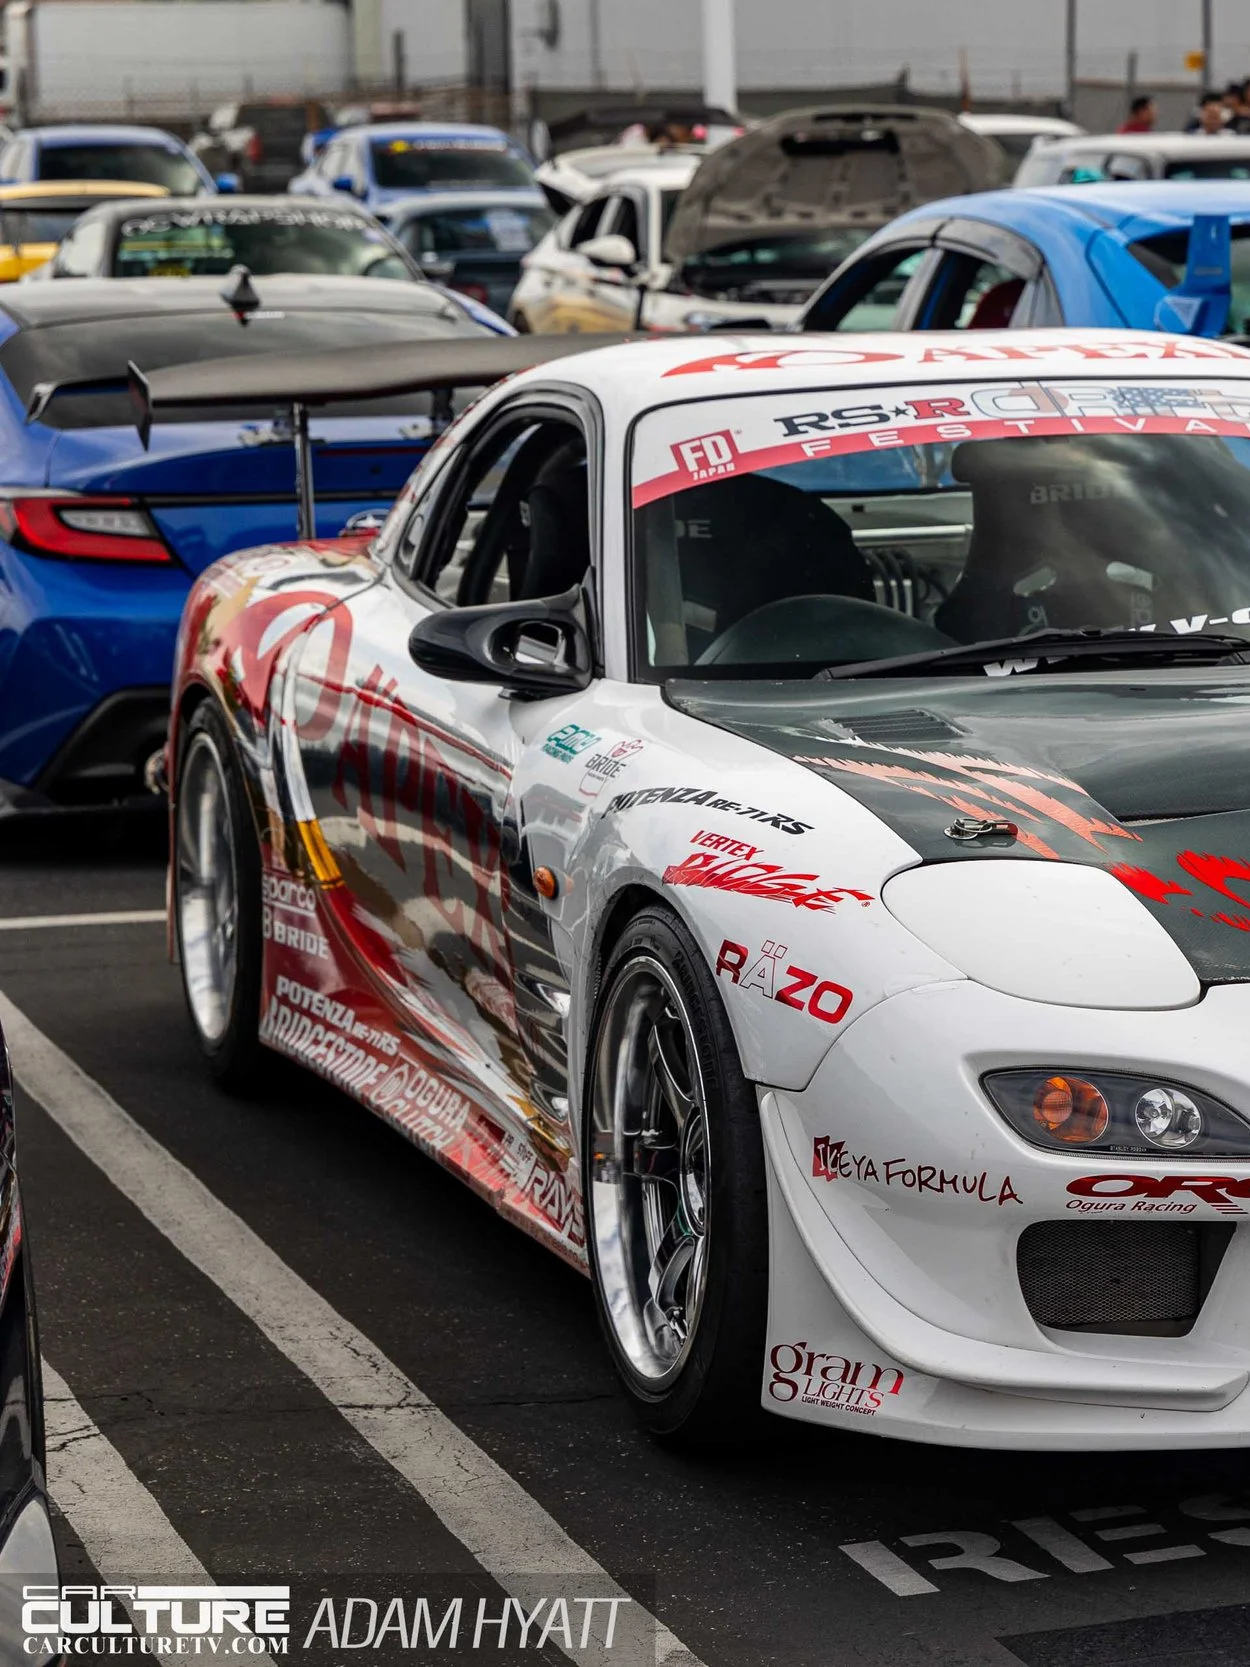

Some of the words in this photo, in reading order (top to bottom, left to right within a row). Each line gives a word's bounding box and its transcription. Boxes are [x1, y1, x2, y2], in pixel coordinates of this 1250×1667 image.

[678, 432, 733, 473] FD
[692, 461, 736, 481] JAPAN
[1029, 483, 1126, 505] BRID
[584, 753, 627, 779] BRIDE
[601, 786, 718, 820] POTENZA
[704, 796, 816, 835] RE-71RS
[689, 829, 765, 862] VERTEX
[273, 920, 330, 960] BRIDE
[715, 938, 854, 1026] RÄZO
[276, 974, 357, 1033] POTENZA
[258, 995, 390, 1092] BRIDGESTONE
[404, 1069, 471, 1132] OGURA
[1065, 1198, 1126, 1213] Ogura
[1130, 1200, 1198, 1215] Racing
[768, 1341, 905, 1402] gram
[801, 1396, 820, 1406] LIGHT
[820, 1399, 845, 1410] WEIGHT
[844, 1404, 876, 1417] CONCEPT
[803, 1378, 885, 1409] LIGHTS
